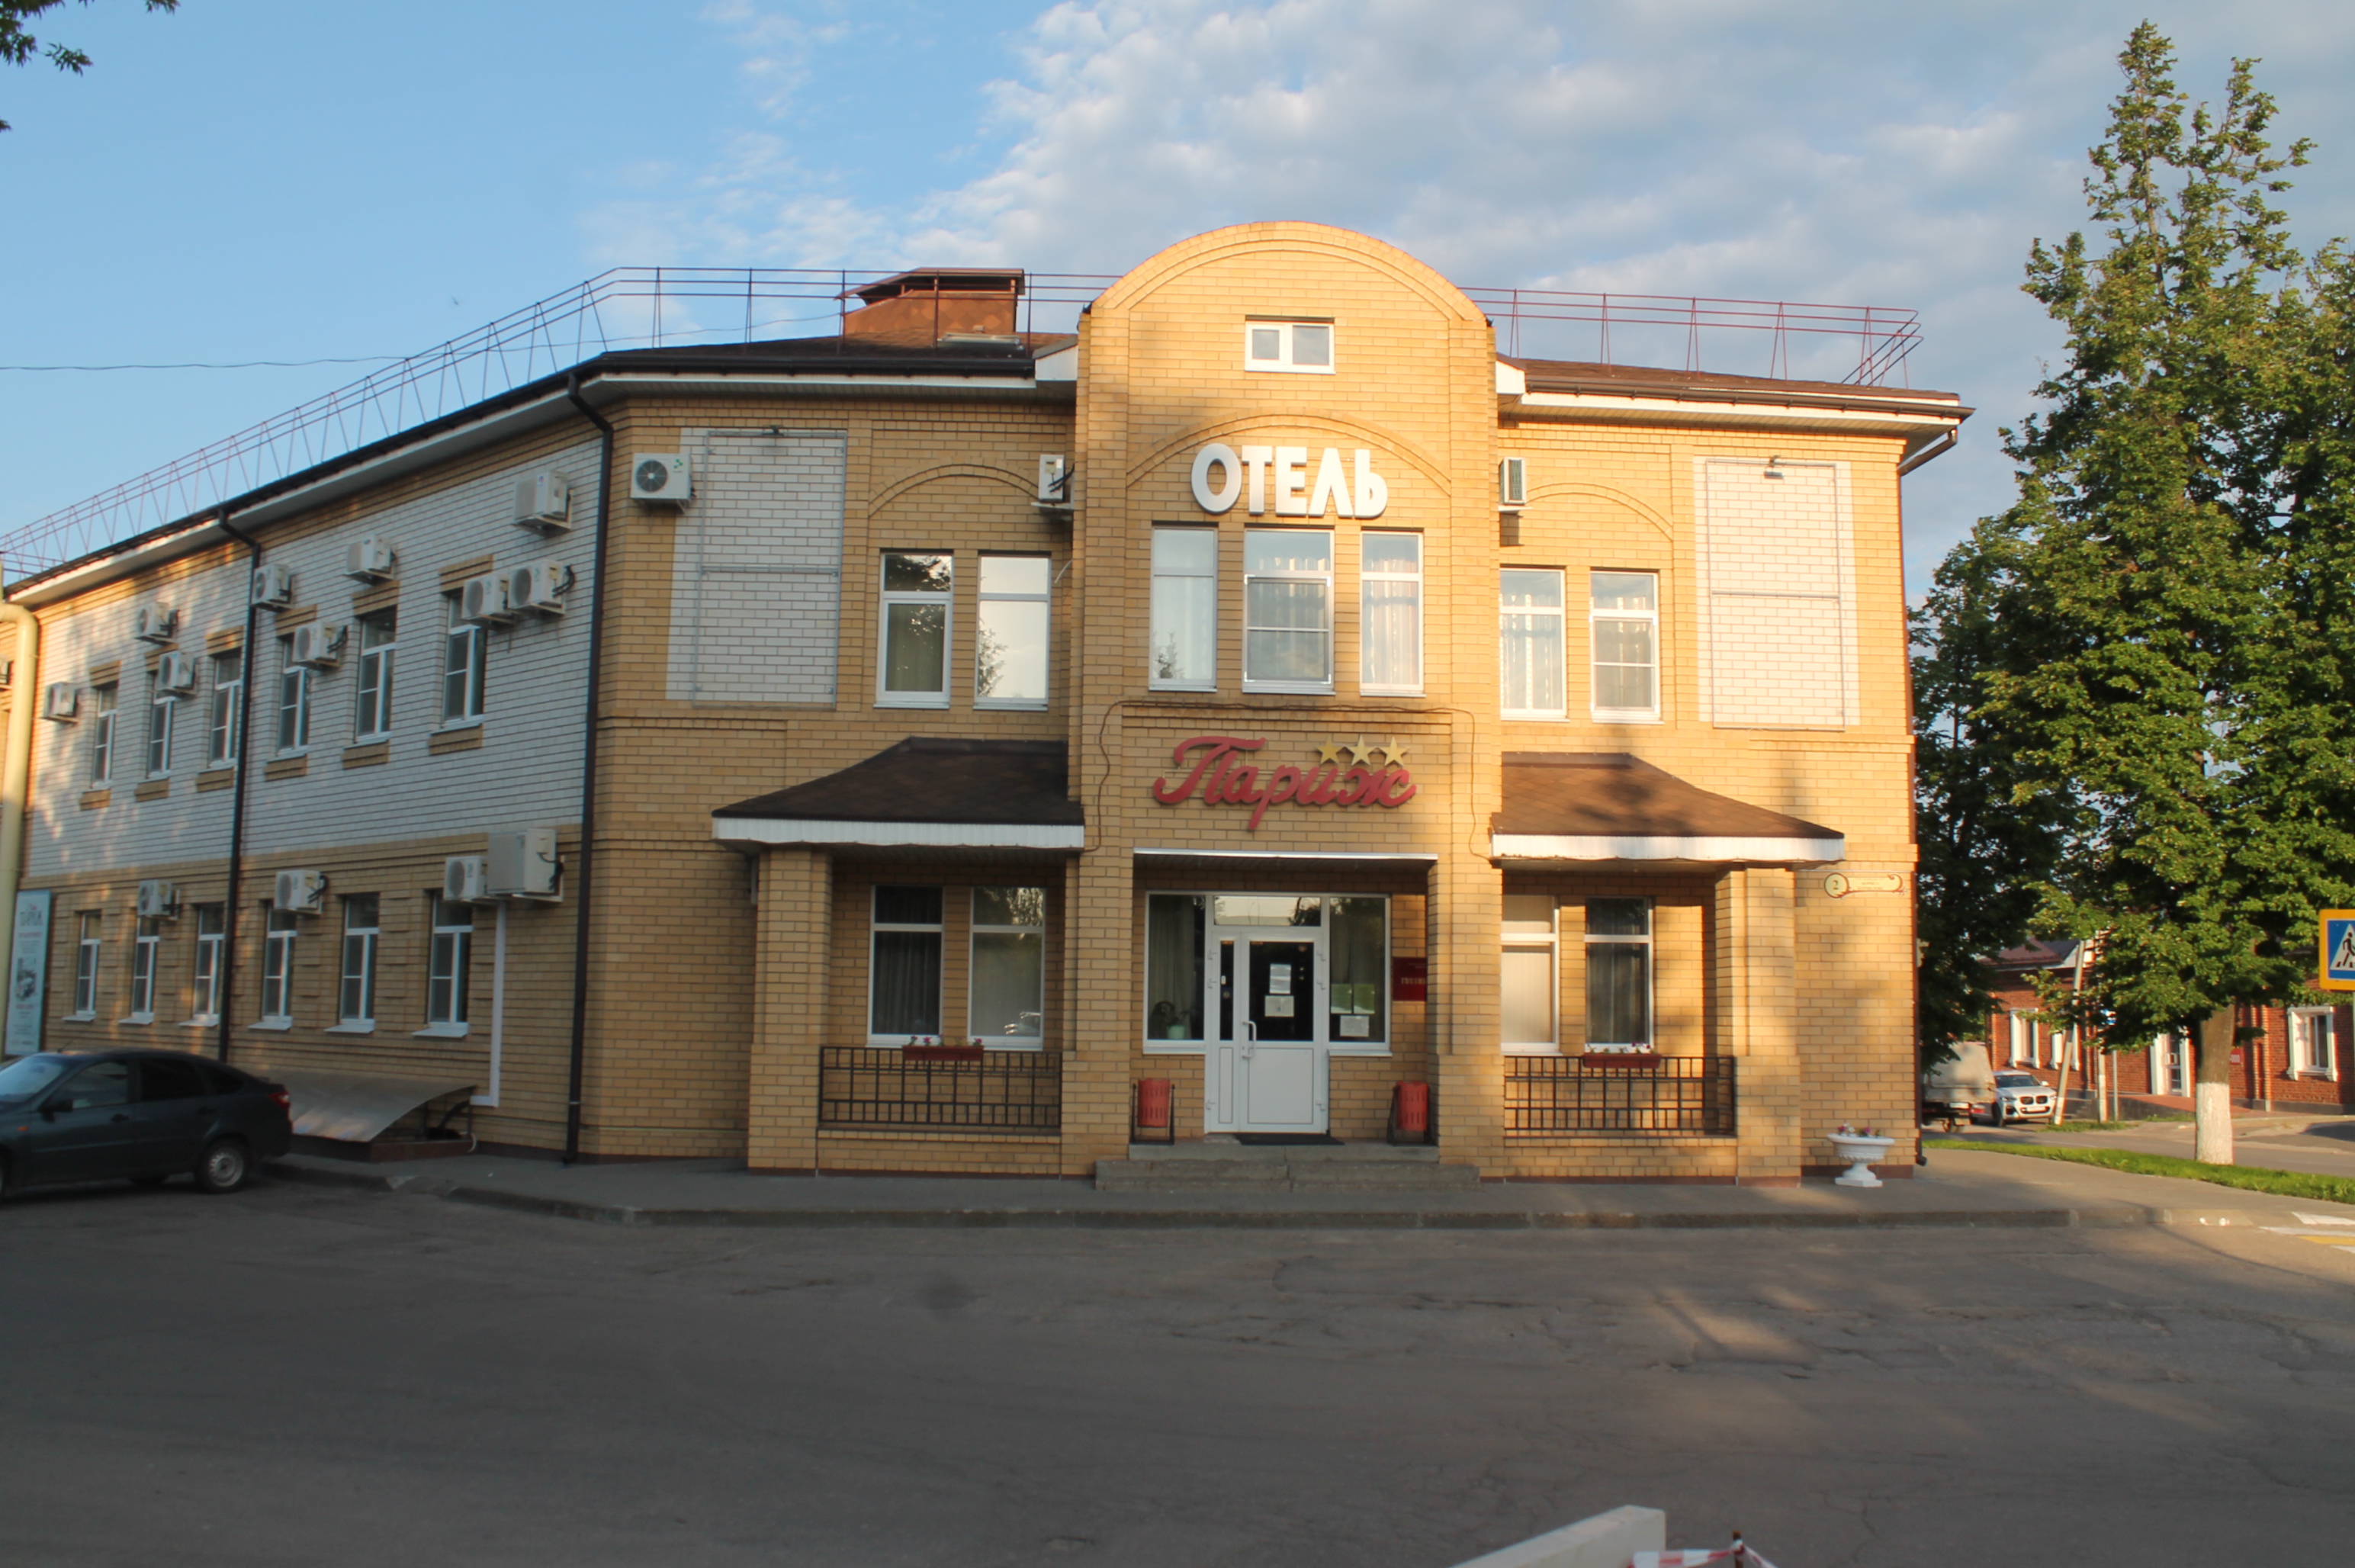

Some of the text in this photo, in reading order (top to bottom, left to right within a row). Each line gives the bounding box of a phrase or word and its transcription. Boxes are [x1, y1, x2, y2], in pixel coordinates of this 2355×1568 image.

[1191, 443, 1388, 519] ОТЕЛЬ
[1153, 736, 1417, 830] Париж
[1832, 879, 1839, 891] 2
